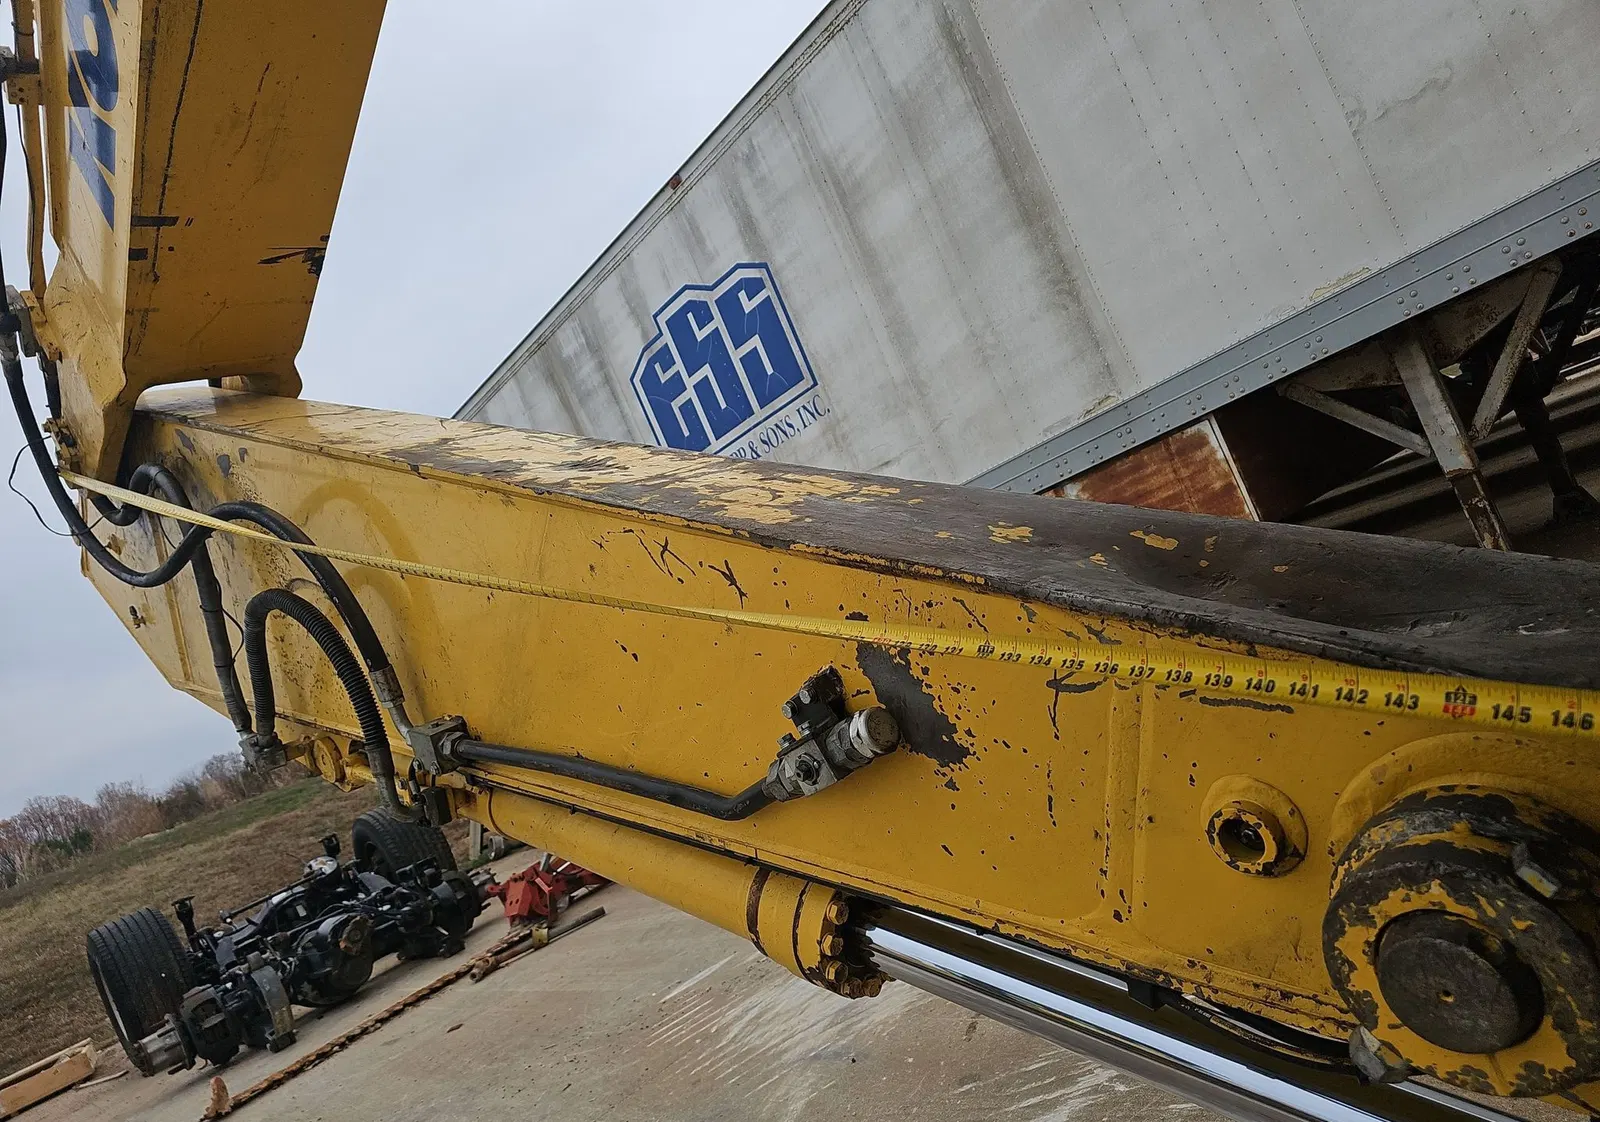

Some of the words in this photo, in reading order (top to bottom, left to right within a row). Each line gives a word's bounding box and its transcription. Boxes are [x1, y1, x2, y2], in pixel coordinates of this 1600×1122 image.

[748, 440, 762, 459] &
[758, 414, 802, 454] SONS,
[796, 394, 831, 430] INC.
[999, 652, 1022, 663] 133
[1029, 655, 1053, 667] 134
[1060, 658, 1085, 671] 135
[1093, 661, 1120, 675] 136
[1129, 665, 1155, 680] 137
[1164, 669, 1193, 684] 138
[1204, 673, 1233, 688] 139
[1244, 677, 1276, 694] 140
[1289, 681, 1320, 699] 141
[1335, 686, 1370, 705] 142
[1384, 691, 1421, 711] 143
[1491, 703, 1533, 724] 145
[1551, 709, 1596, 731] 146
[1215, 665, 1222, 673] 7
[1301, 673, 1308, 682] 9
[1344, 678, 1356, 687] 10
